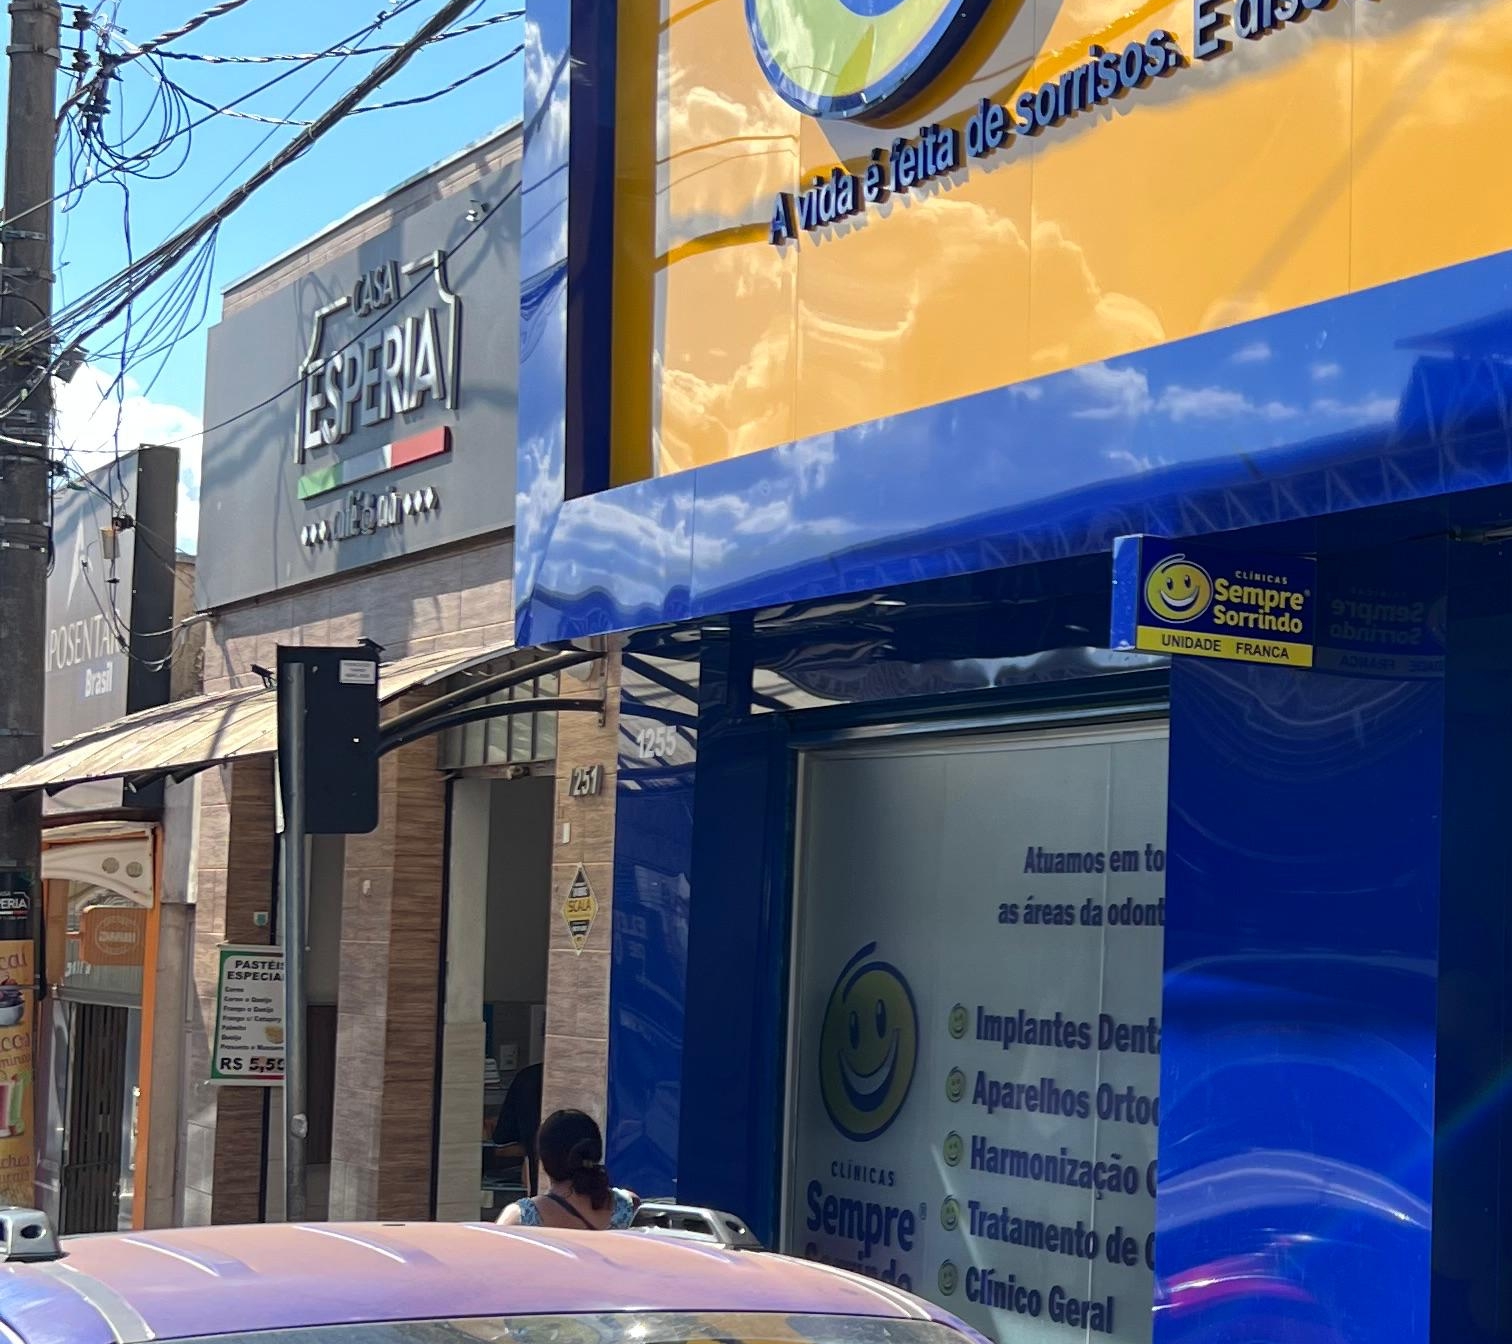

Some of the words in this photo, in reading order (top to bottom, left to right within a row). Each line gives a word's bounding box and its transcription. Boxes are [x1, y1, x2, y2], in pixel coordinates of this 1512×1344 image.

[769, 191, 798, 246] A
[797, 167, 859, 233] vida
[863, 147, 890, 204] é
[888, 122, 959, 193] feita
[966, 97, 1010, 157] de
[1014, 27, 1186, 138] sorrisos.
[353, 259, 399, 318] CASA
[304, 306, 446, 450] ESPERIA
[1212, 605, 1303, 634] Sorrindo
[1213, 577, 1305, 614] Sempre
[1161, 633, 1222, 653] UNIDADE
[1235, 642, 1290, 661] FRANCA
[85, 660, 114, 698] Brasil
[636, 725, 677, 759] 1255
[1023, 846, 1105, 874] Atuamos
[1109, 849, 1140, 873] em
[1145, 843, 1166, 872] to
[998, 902, 1019, 925] as
[1023, 894, 1076, 926] áreas
[1080, 898, 1104, 927] da
[975, 1005, 1092, 1051] Implantes
[1097, 1012, 1163, 1056] Dent
[971, 1070, 1091, 1120] Aparelhos
[831, 1159, 897, 1188] CLÍNICAS
[970, 1134, 1139, 1201] Harmonização
[806, 1179, 916, 1258] Sempre
[968, 1200, 1099, 1261] Tratamento
[1105, 1225, 1139, 1267] de
[965, 1265, 1042, 1318] Clínico
[1048, 1284, 1115, 1335] Geral
